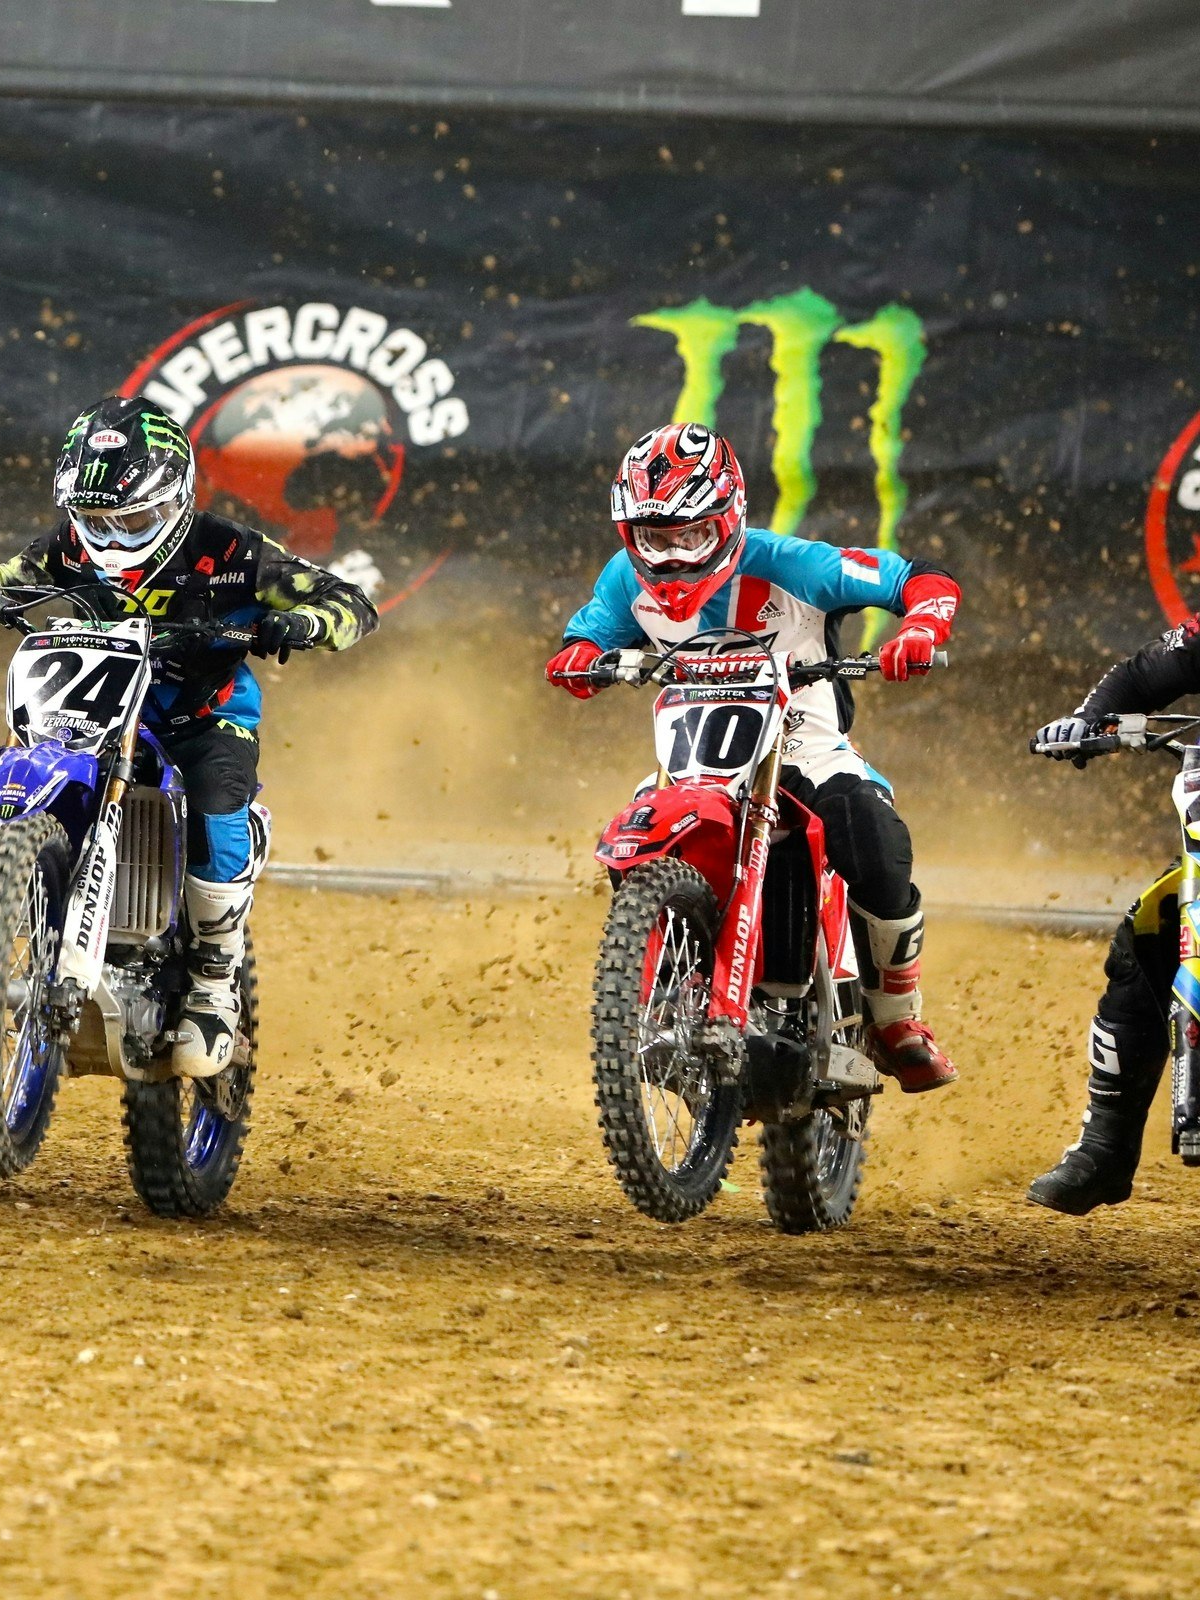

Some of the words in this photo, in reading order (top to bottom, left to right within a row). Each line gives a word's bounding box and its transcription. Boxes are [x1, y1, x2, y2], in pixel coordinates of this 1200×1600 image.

[142, 302, 470, 446] UPERCROSS
[94, 434, 121, 444] BELL
[115, 467, 140, 492] POLAR
[636, 502, 665, 511] SHOEI
[209, 572, 245, 585] MAHA
[757, 610, 786, 622] adidas
[61, 635, 108, 646] MONSTER
[222, 630, 254, 642] ARC
[838, 666, 866, 676] ARC
[27, 651, 142, 730] 24
[698, 688, 746, 698] MONSTER
[41, 715, 100, 735] FERRANDIS
[667, 705, 764, 773] 10
[75, 846, 107, 953] DUNLOP
[726, 903, 753, 1004] DUNLOP
[1178, 1054, 1188, 1106] TEXTRON
